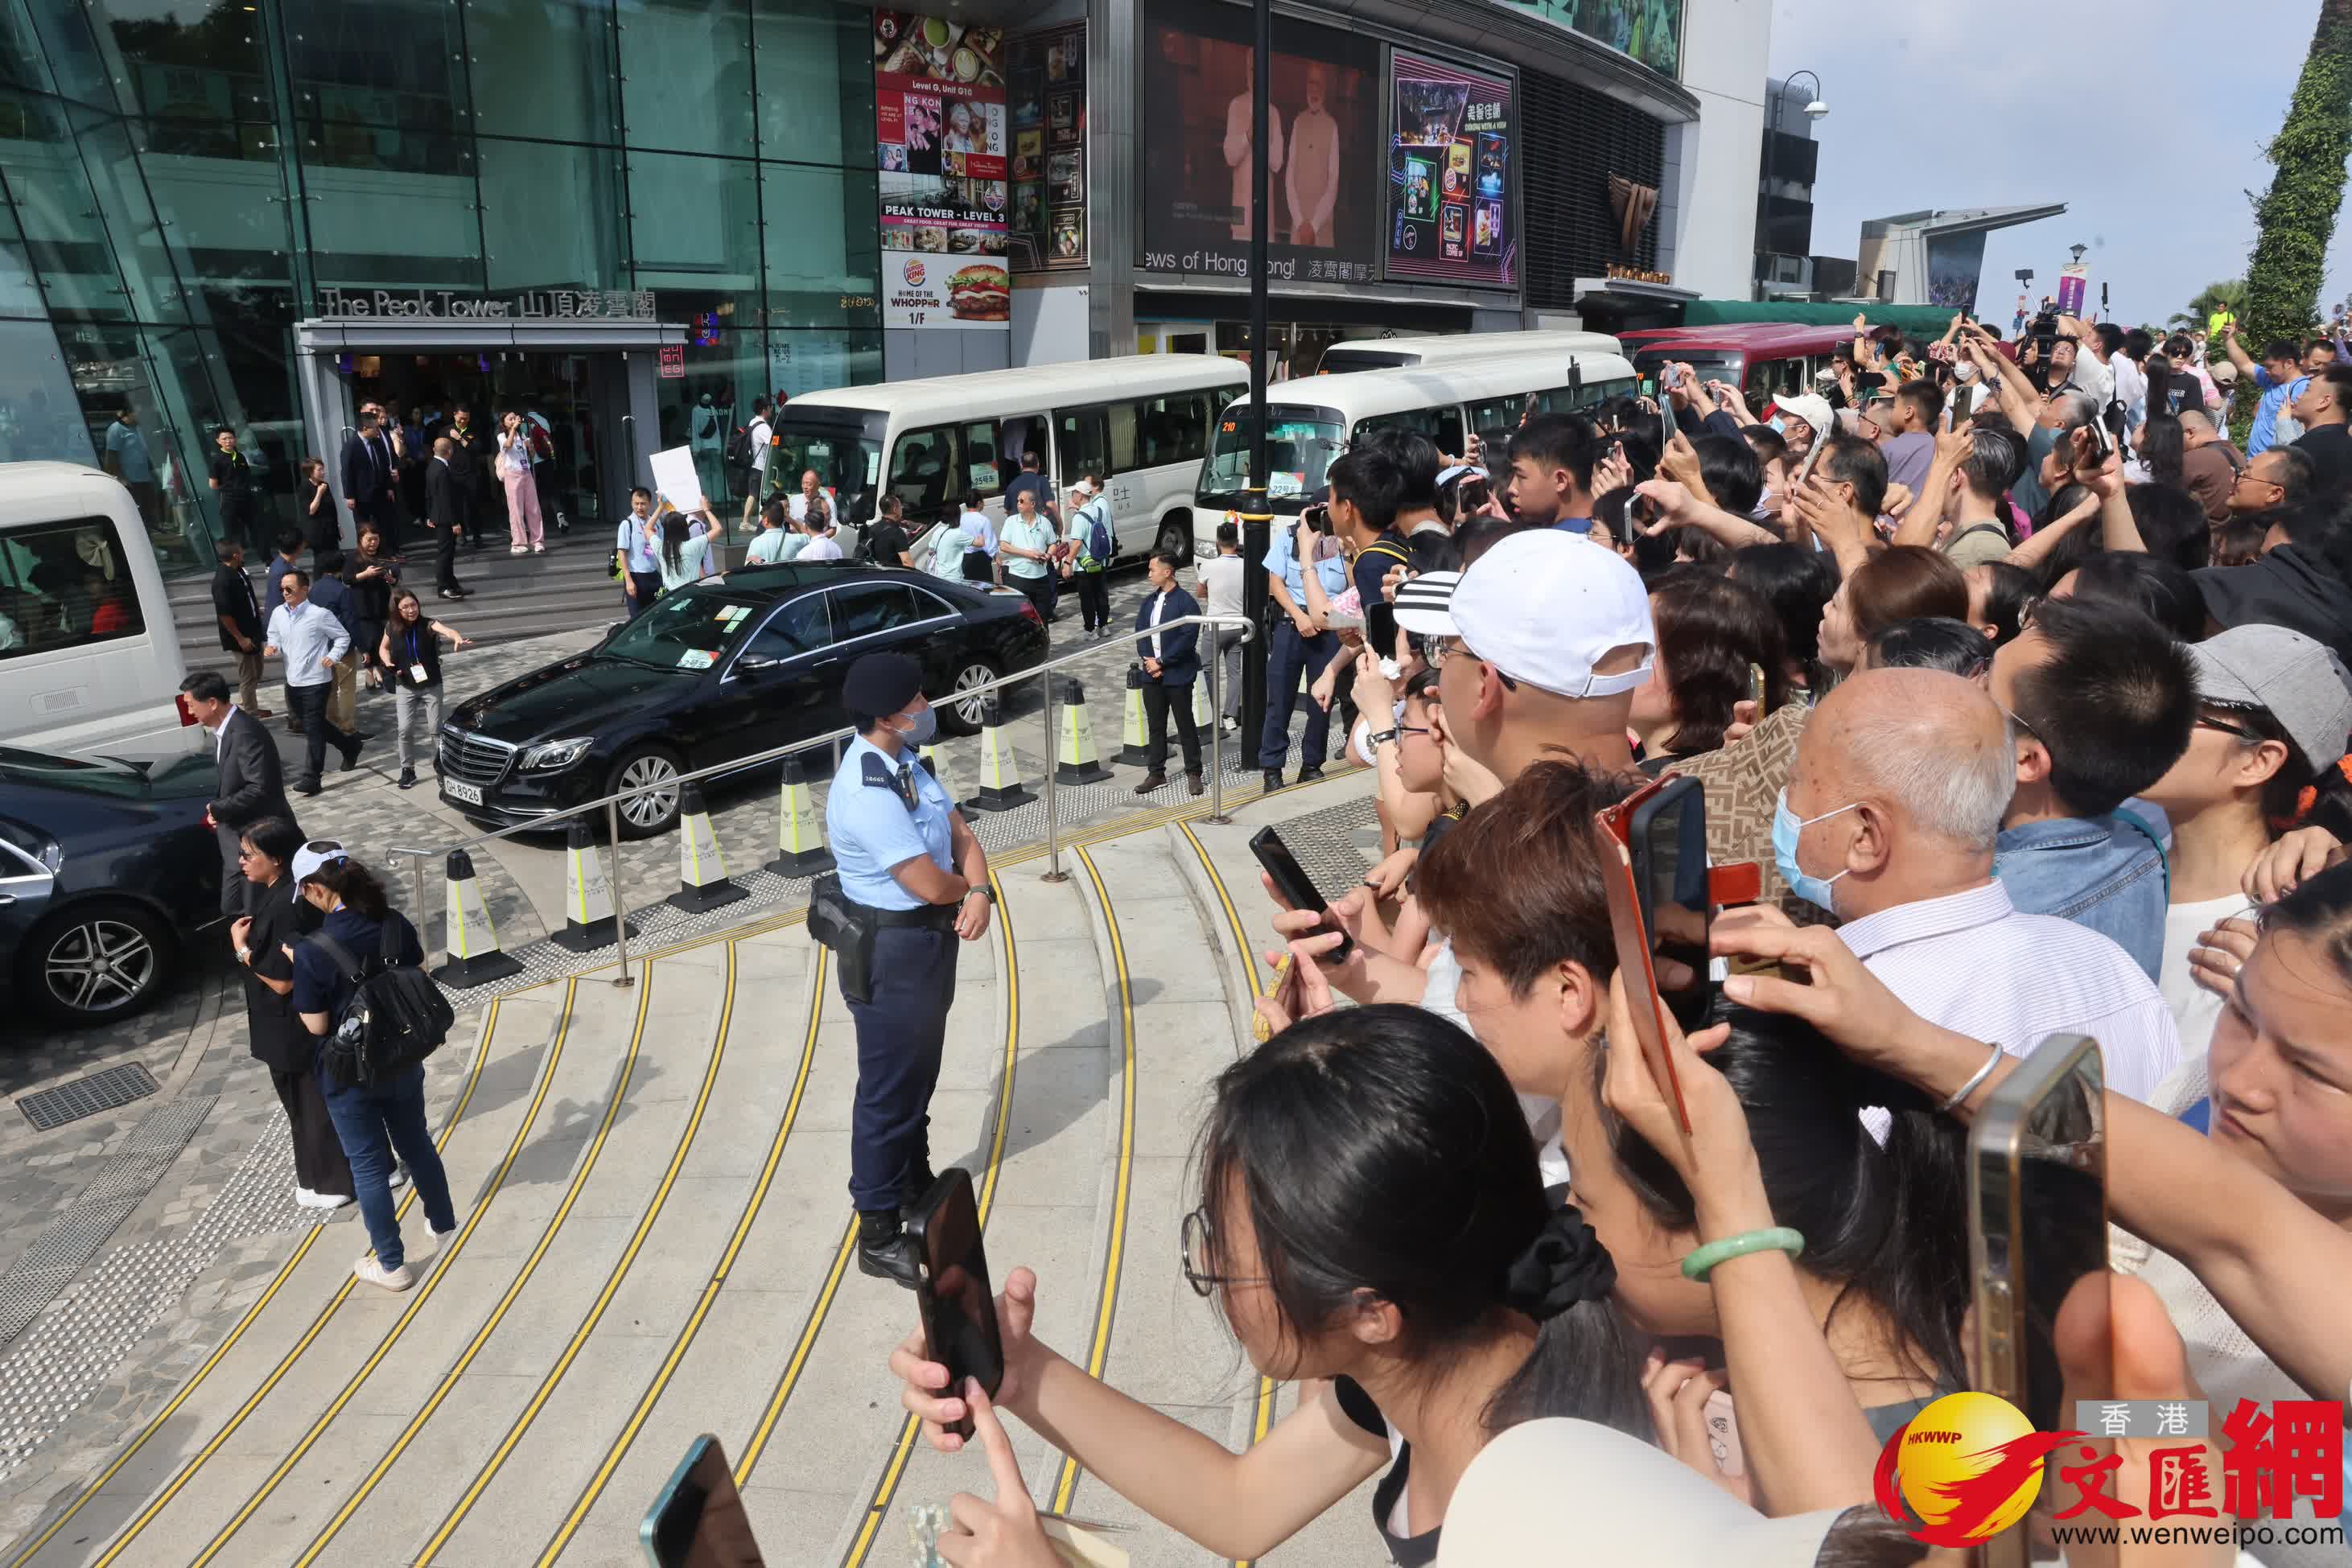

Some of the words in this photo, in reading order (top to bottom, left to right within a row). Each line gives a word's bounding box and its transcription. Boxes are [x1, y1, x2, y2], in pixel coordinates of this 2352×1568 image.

[912, 80, 932, 91] Level
[933, 84, 941, 93] G,
[942, 85, 956, 95] Unit
[958, 87, 972, 96] G10
[885, 205, 915, 216] PEAK
[917, 208, 954, 219] TOWER
[964, 212, 995, 222] LEVEL
[999, 213, 1005, 222] 3
[906, 263, 924, 274] BURGER
[1183, 251, 1199, 269] of
[1205, 253, 1246, 277] Hong
[1267, 257, 1295, 279] ong!
[907, 269, 925, 281] KING
[320, 288, 369, 316] The
[374, 290, 435, 318] Peak
[437, 291, 513, 318] Tower
[519, 290, 656, 318] 山頂凌霄閣
[891, 298, 940, 307] WHOPPER
[909, 313, 925, 324] 1/F
[1222, 422, 1237, 431] 210
[457, 784, 479, 801] 8926
